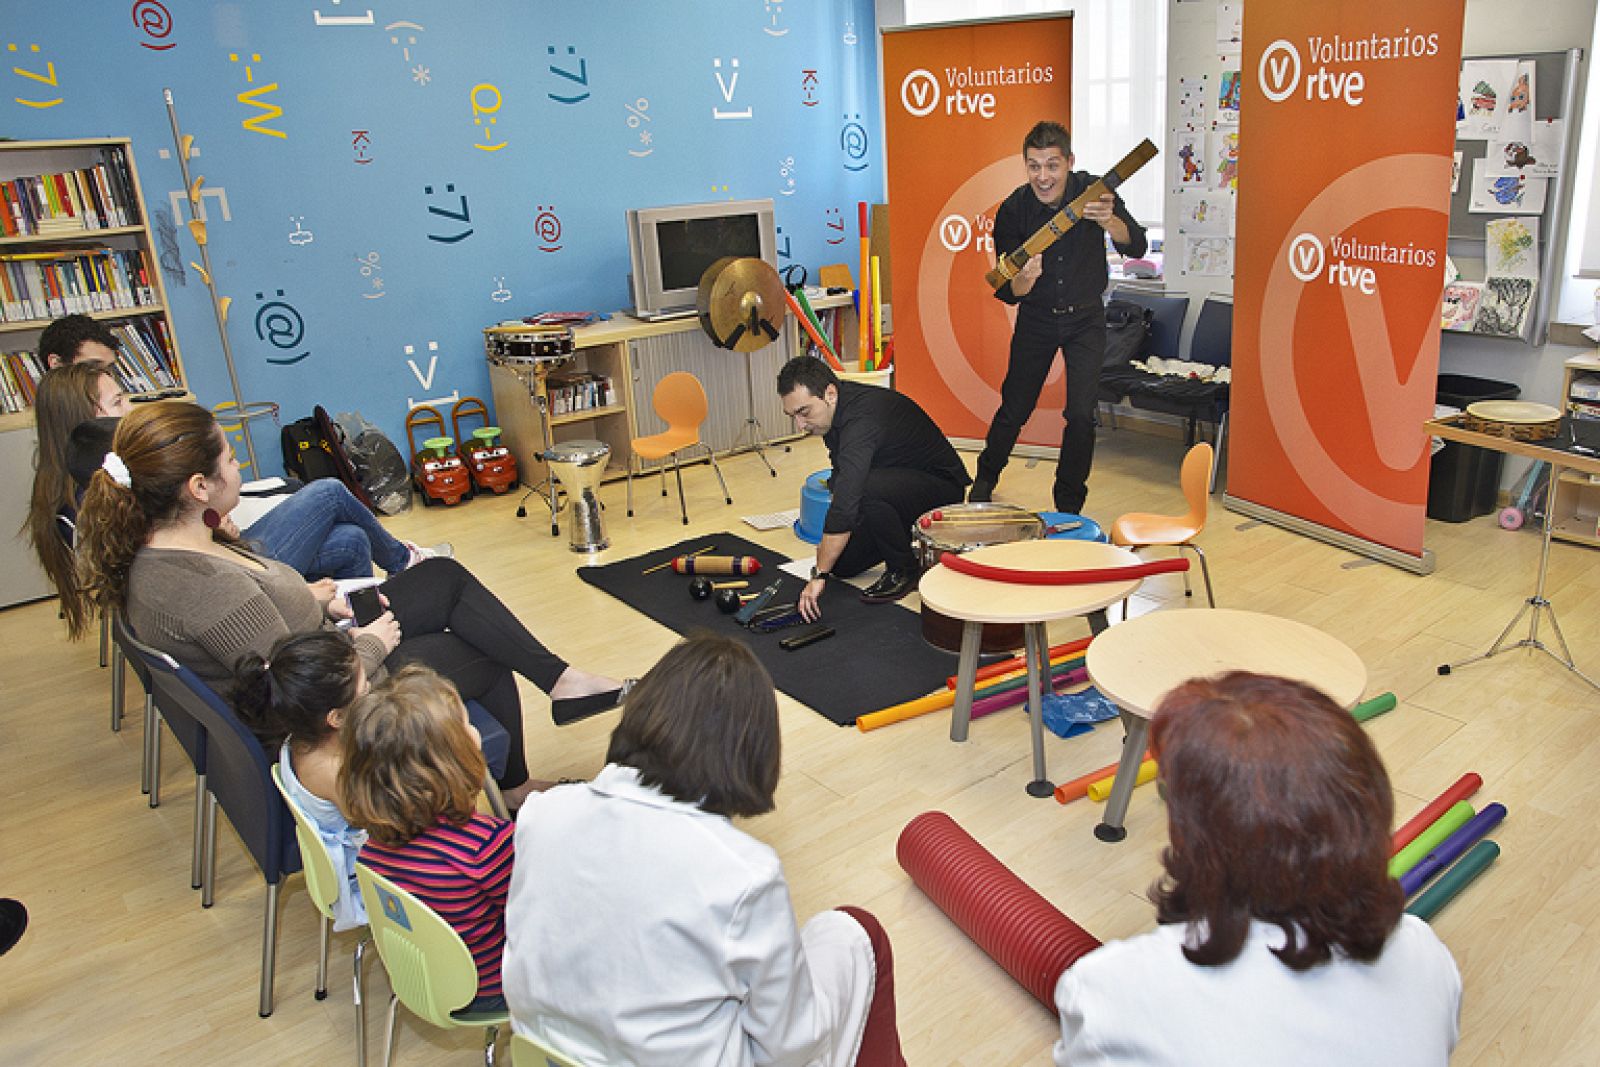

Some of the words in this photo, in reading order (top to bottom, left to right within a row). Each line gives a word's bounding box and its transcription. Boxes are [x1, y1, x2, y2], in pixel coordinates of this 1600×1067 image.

[1307, 27, 1439, 64] Voluntarios
[944, 62, 1053, 88] Voluntarios
[1305, 66, 1365, 106] rtve
[945, 89, 996, 118] rtve
[976, 231, 994, 252] rt
[1330, 236, 1437, 267] Voluntarios
[1328, 260, 1376, 295] rtve
